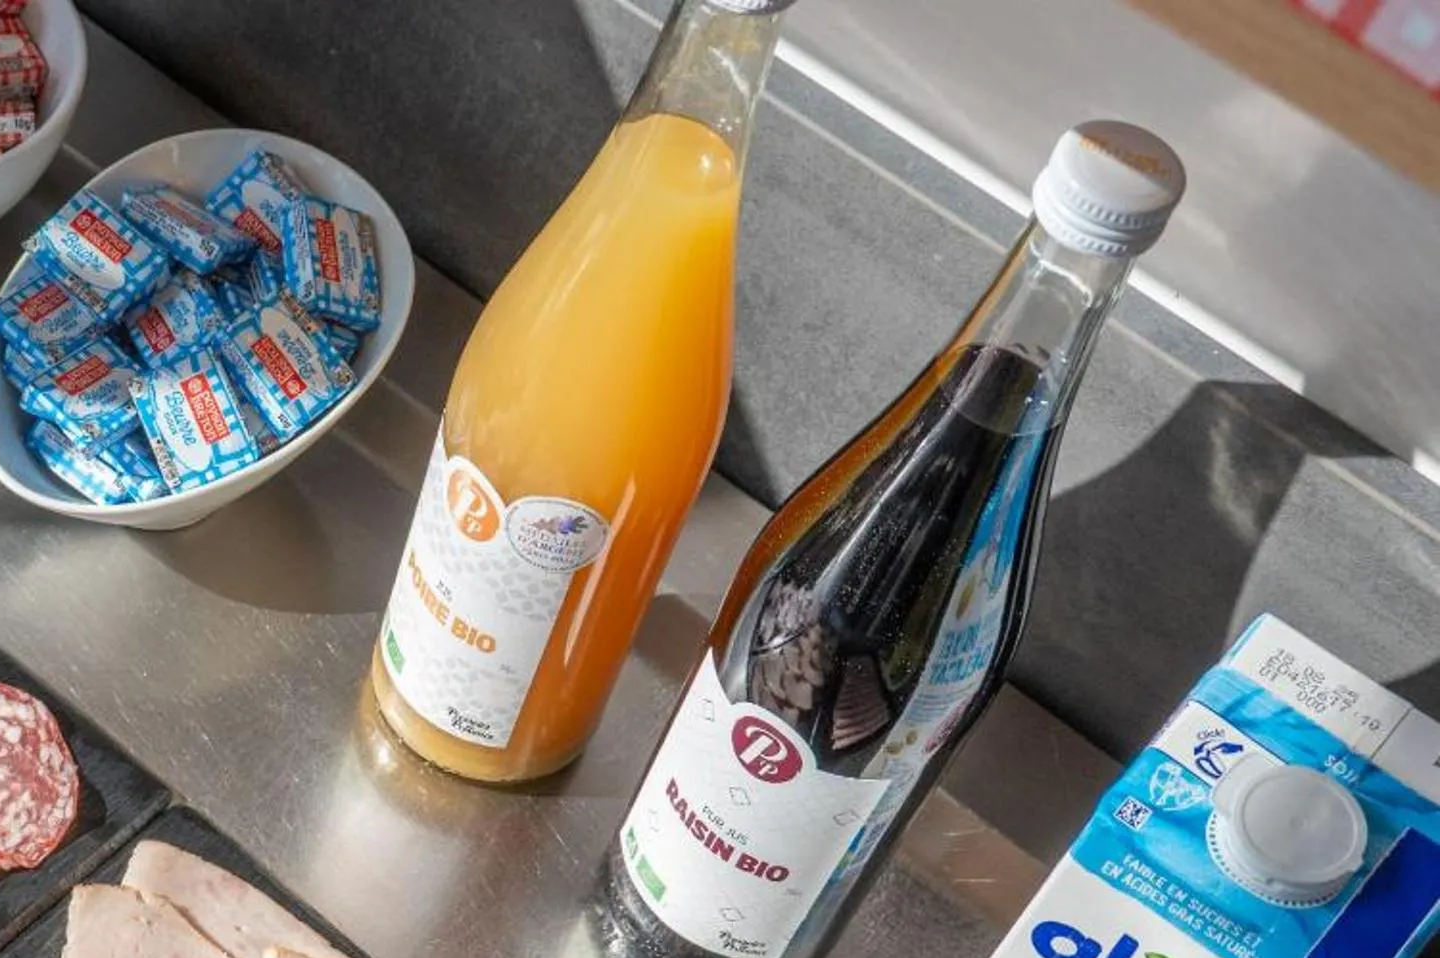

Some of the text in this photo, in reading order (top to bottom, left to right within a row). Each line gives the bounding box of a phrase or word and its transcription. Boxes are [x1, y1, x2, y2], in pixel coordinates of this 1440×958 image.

[164, 390, 197, 446] Beurre
[451, 615, 497, 654] BIO
[665, 776, 790, 883] RAISIN BIO
[1100, 859, 1124, 880] EN
[1121, 871, 1168, 907] ACIDES
[1168, 900, 1203, 931] GRAS
[1121, 852, 1264, 949] FAIBLE EN SUCRES ET
